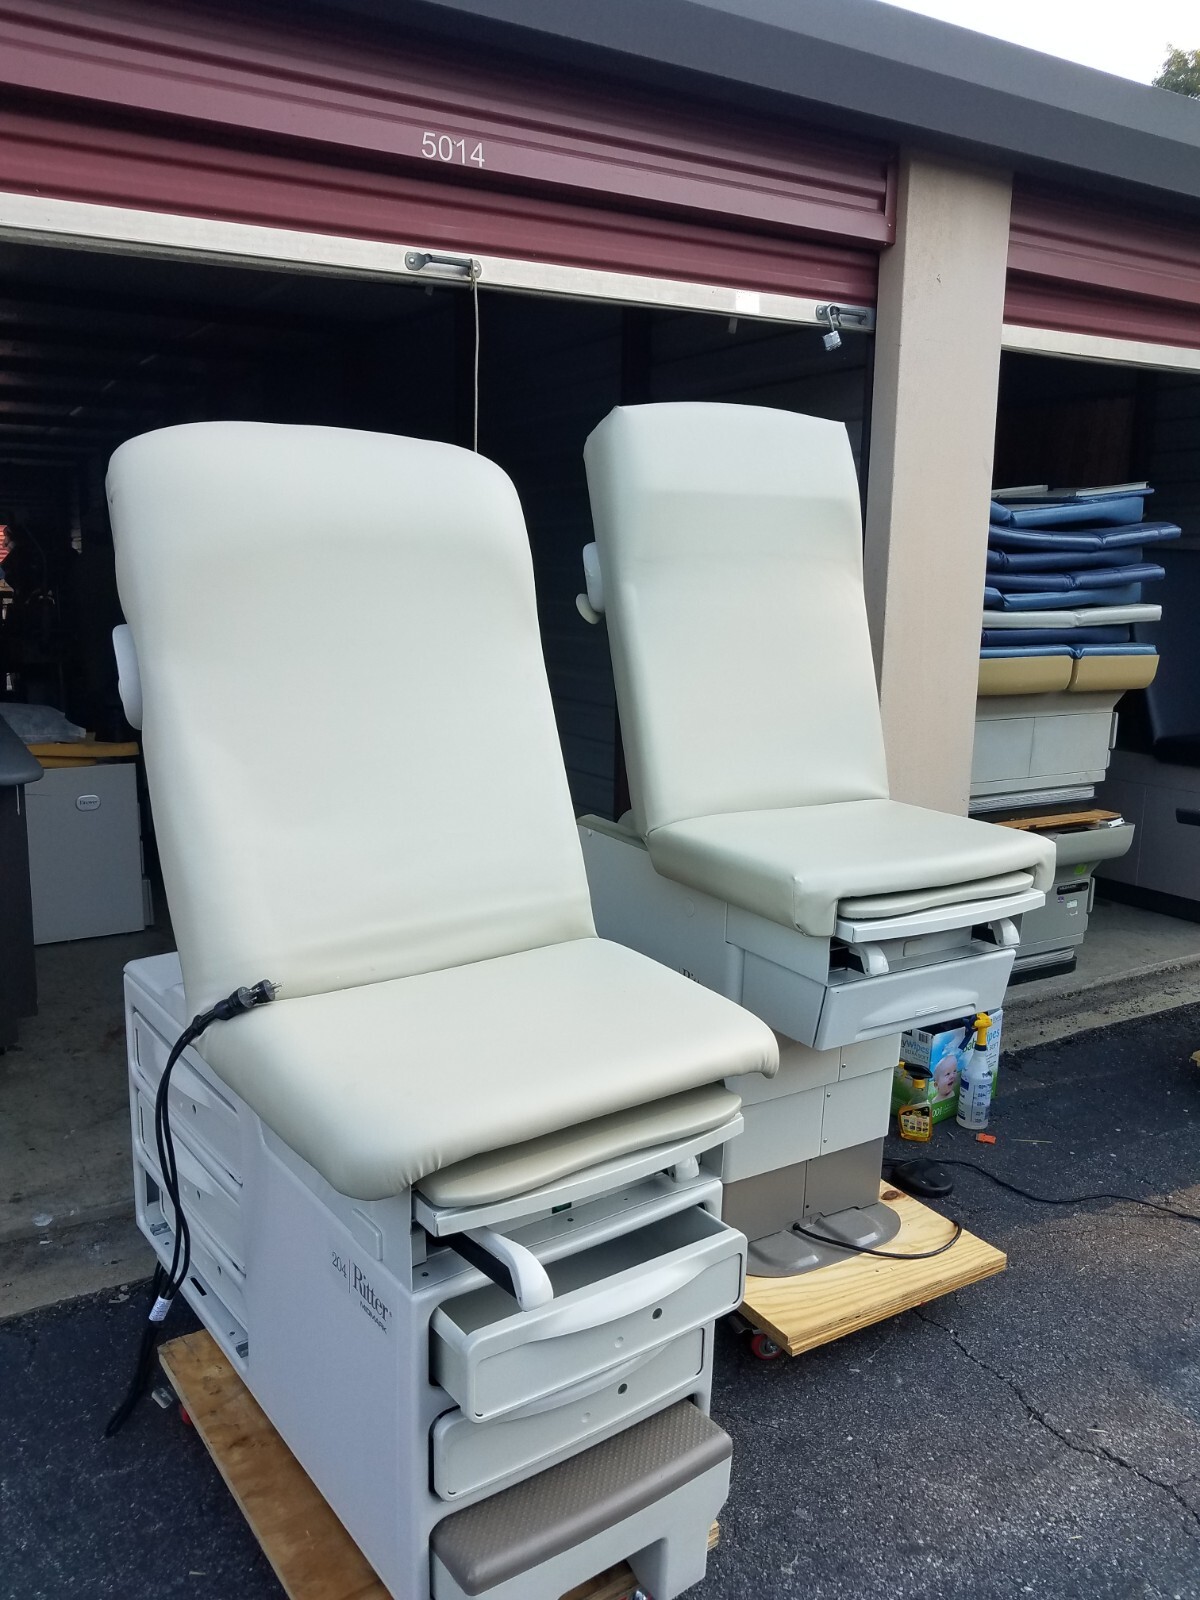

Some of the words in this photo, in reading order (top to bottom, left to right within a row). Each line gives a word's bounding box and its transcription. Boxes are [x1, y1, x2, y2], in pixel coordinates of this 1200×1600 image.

[421, 131, 485, 168] 5014
[331, 1251, 348, 1279] 204
[353, 1262, 389, 1322] Ritter
